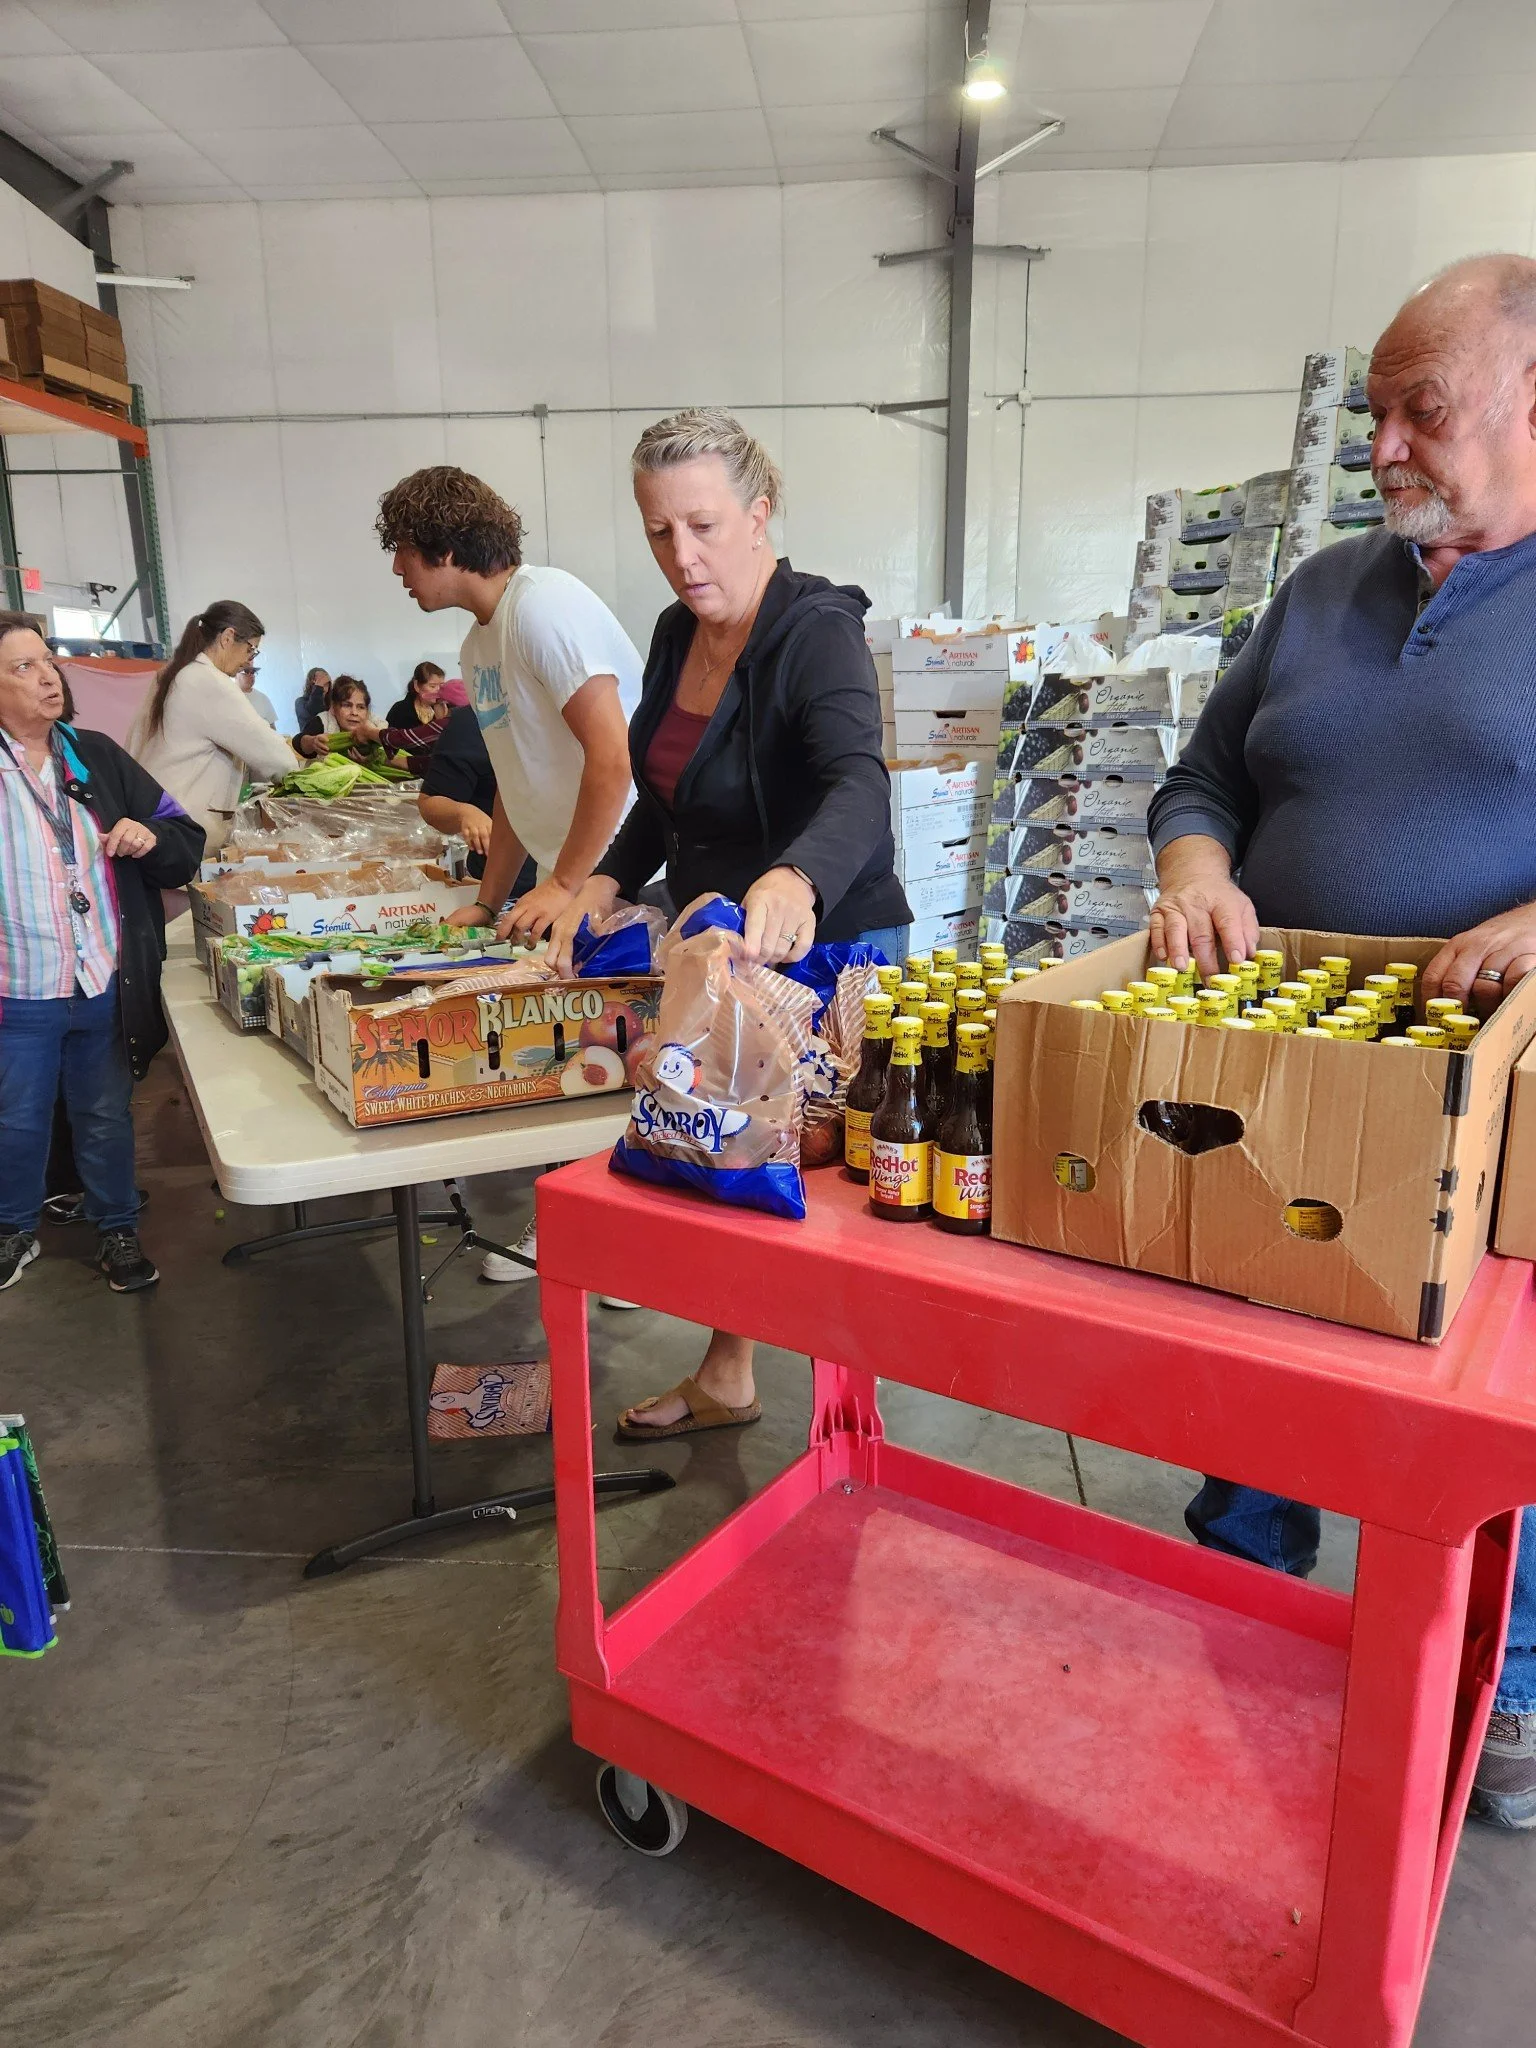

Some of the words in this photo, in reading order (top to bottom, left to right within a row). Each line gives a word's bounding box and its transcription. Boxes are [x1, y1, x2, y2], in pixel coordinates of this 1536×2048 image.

[948, 651, 978, 659] ARTISAN
[1096, 686, 1145, 709] Organic
[1090, 739, 1139, 761] Organic
[1083, 790, 1131, 811] Organic
[1079, 841, 1126, 862] Organic
[378, 902, 436, 918] ARTISAN
[1074, 891, 1122, 911] Organic
[311, 919, 352, 935] Stemilt
[385, 915, 431, 930] naturals
[476, 989, 604, 1042] BLANCO
[363, 1081, 428, 1100] California
[364, 1102, 396, 1117] SWEET
[397, 1096, 428, 1112] WHITE
[428, 1091, 466, 1107] PEACHES
[487, 1080, 537, 1099] NECTARINES
[870, 1149, 918, 1174] RedHot
[870, 1168, 912, 1188] Wings
[954, 1167, 992, 1187] Red
[959, 1186, 992, 1201] Win
